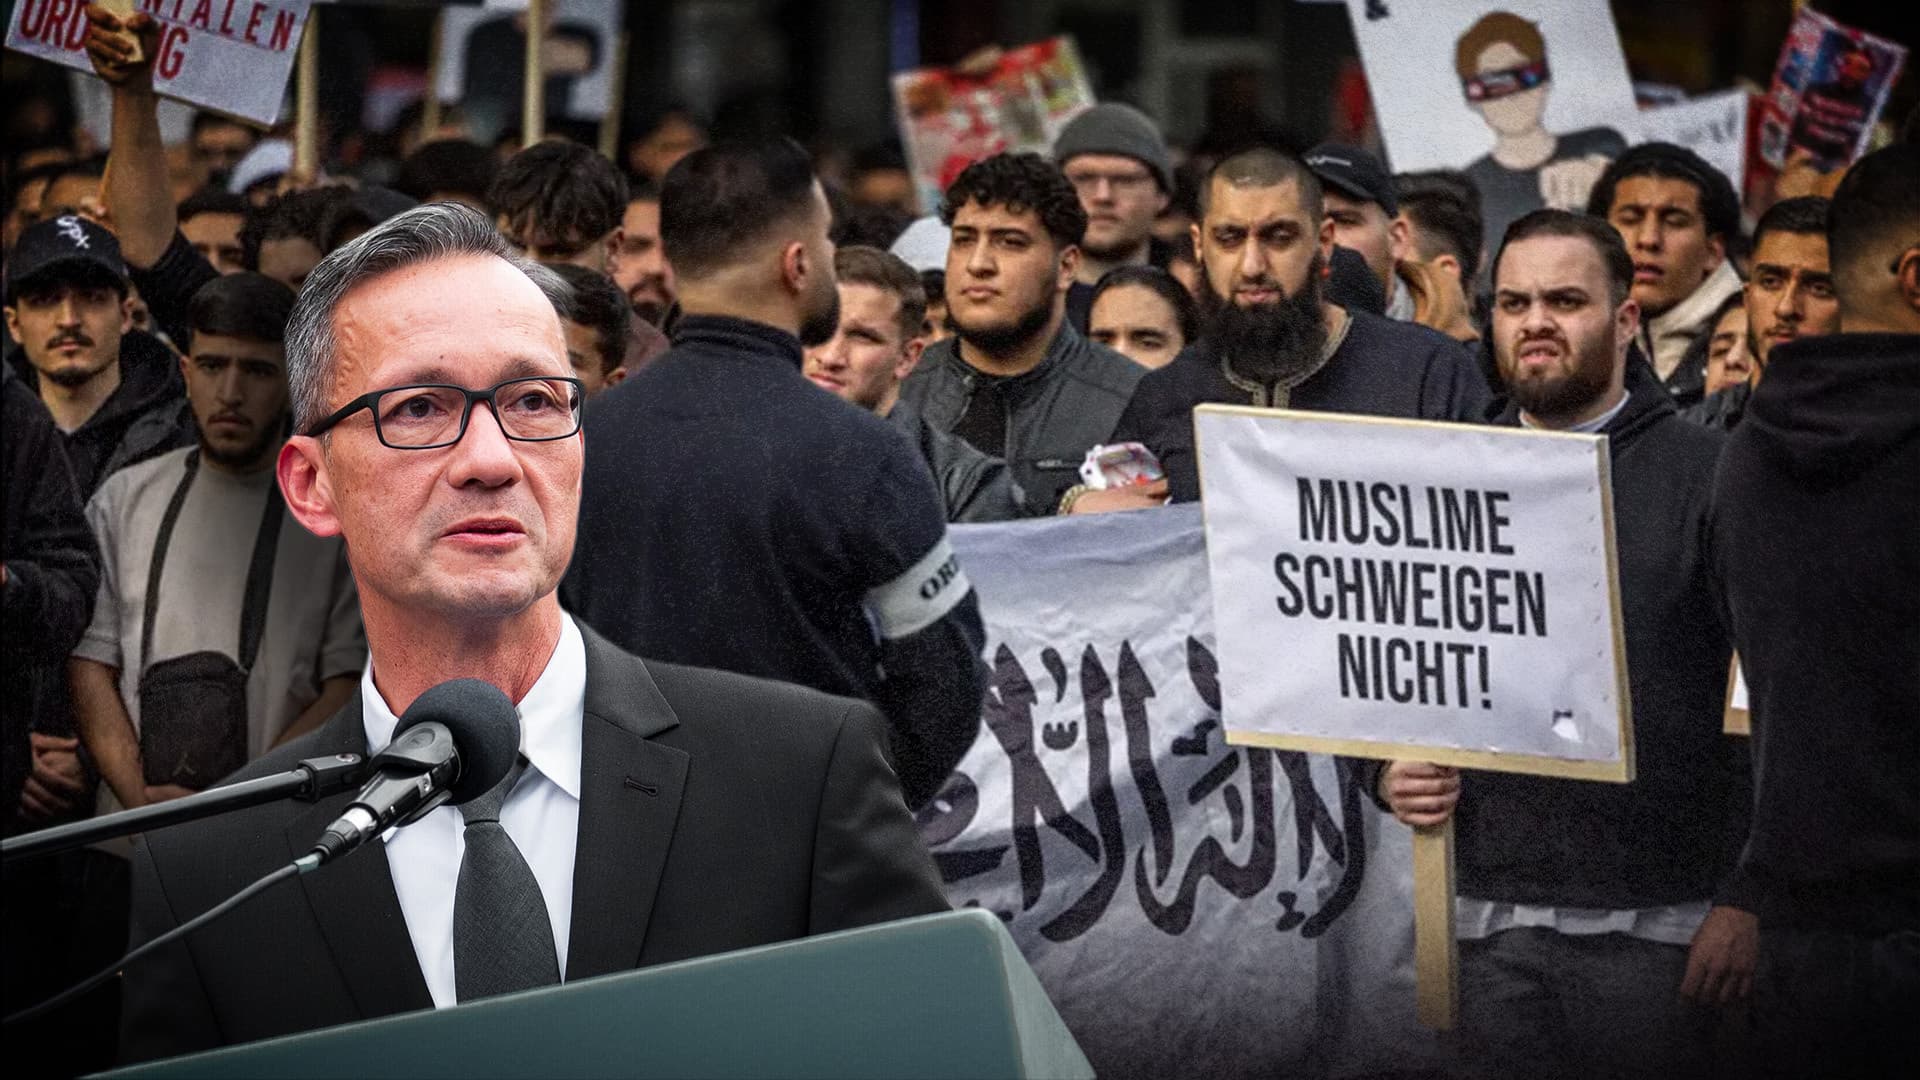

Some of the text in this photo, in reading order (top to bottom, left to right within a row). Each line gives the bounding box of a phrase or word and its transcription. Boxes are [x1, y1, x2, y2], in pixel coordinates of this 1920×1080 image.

[19, 0, 190, 80] ORDG
[1296, 476, 1515, 555] MUSLIME
[1273, 551, 1548, 637] SCHWEIGEN
[1336, 632, 1493, 710] NICHT!
